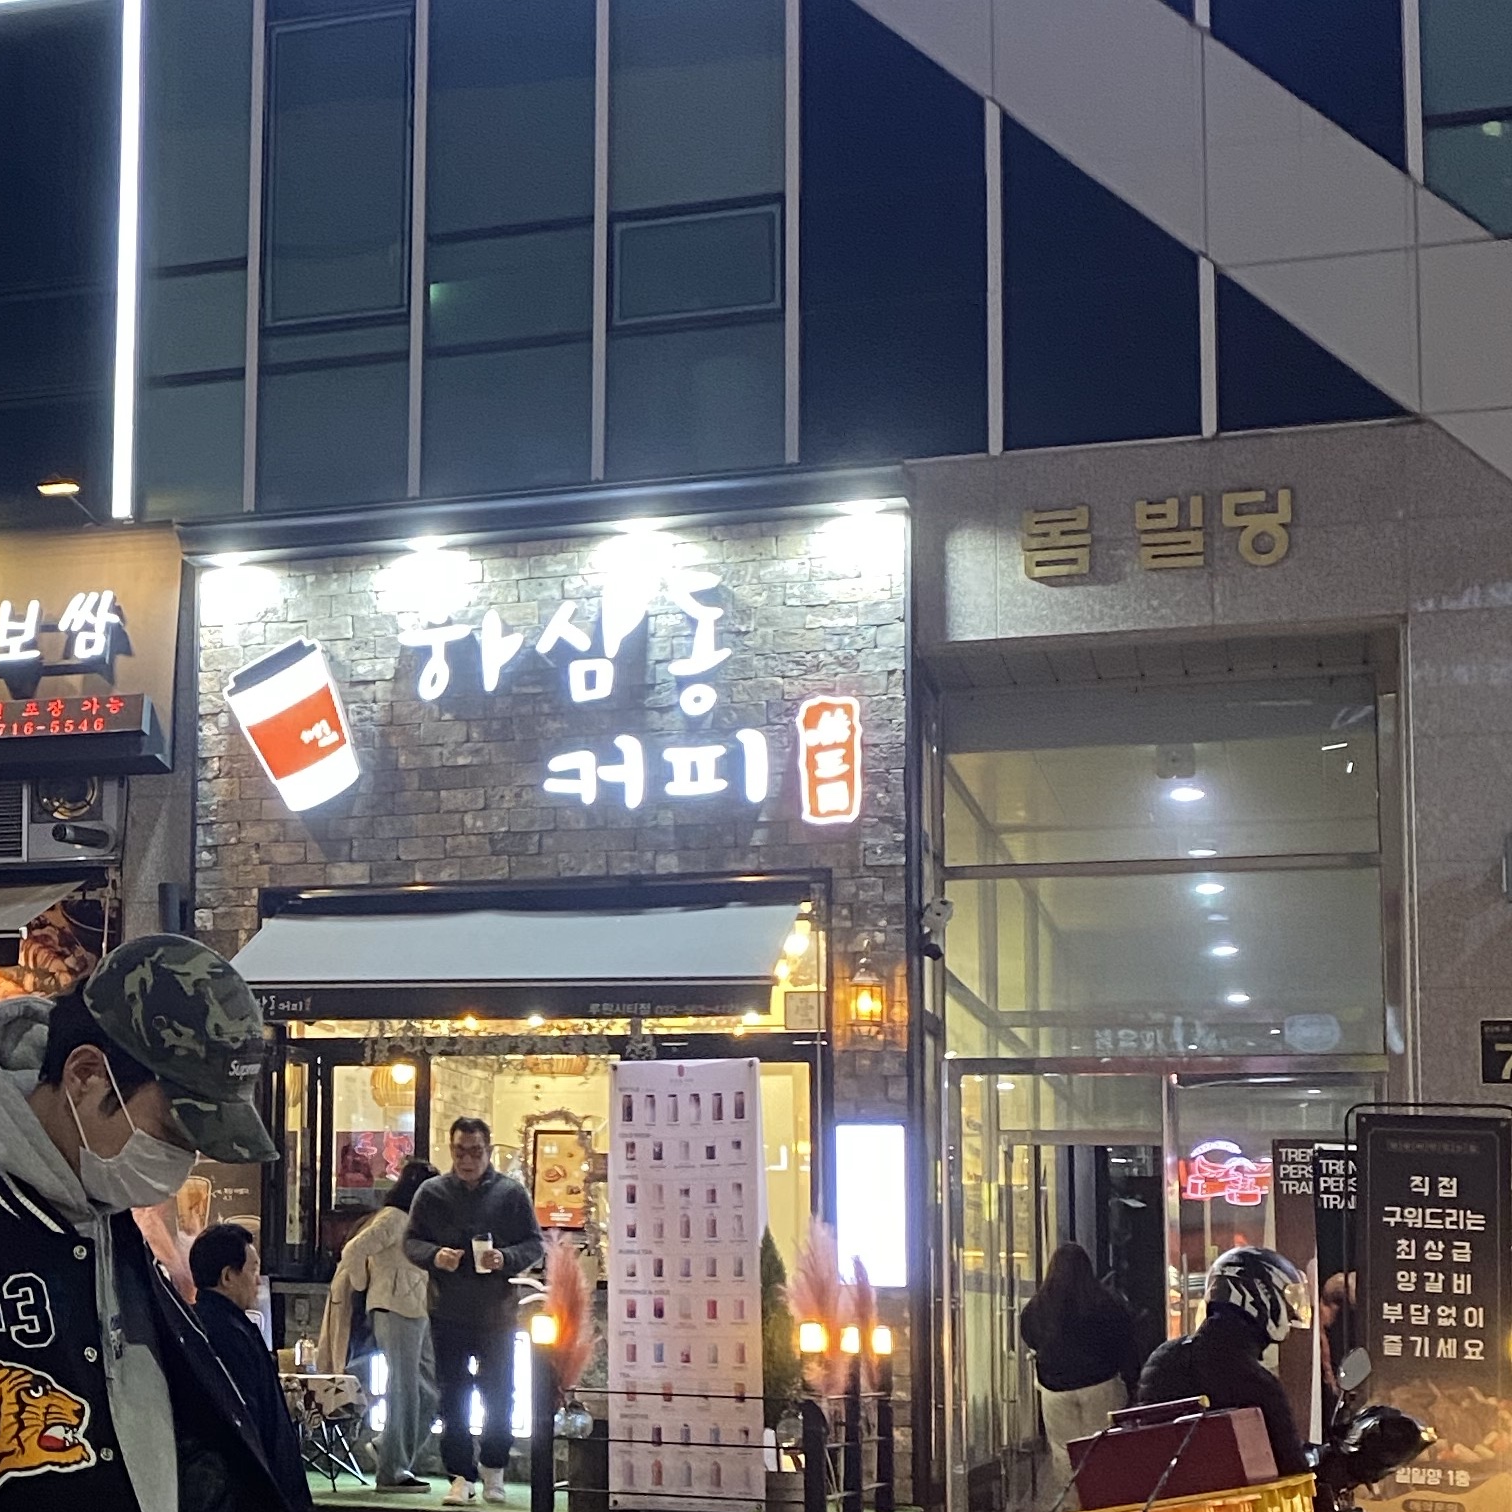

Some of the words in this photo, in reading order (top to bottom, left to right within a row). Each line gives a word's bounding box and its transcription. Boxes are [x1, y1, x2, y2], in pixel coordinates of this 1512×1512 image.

[1135, 488, 1292, 570] 빌딩
[21, 700, 65, 718] 포장
[80, 697, 125, 715] 가능
[542, 728, 770, 809] 커피
[1409, 1175, 1459, 1198] 직접
[1382, 1205, 1487, 1232] 구워드리는
[1395, 1239, 1473, 1263] 최상급
[1396, 1270, 1473, 1295] 양갈비
[1382, 1302, 1486, 1329] 부담없이
[1382, 1334, 1486, 1361] 즐기세요
